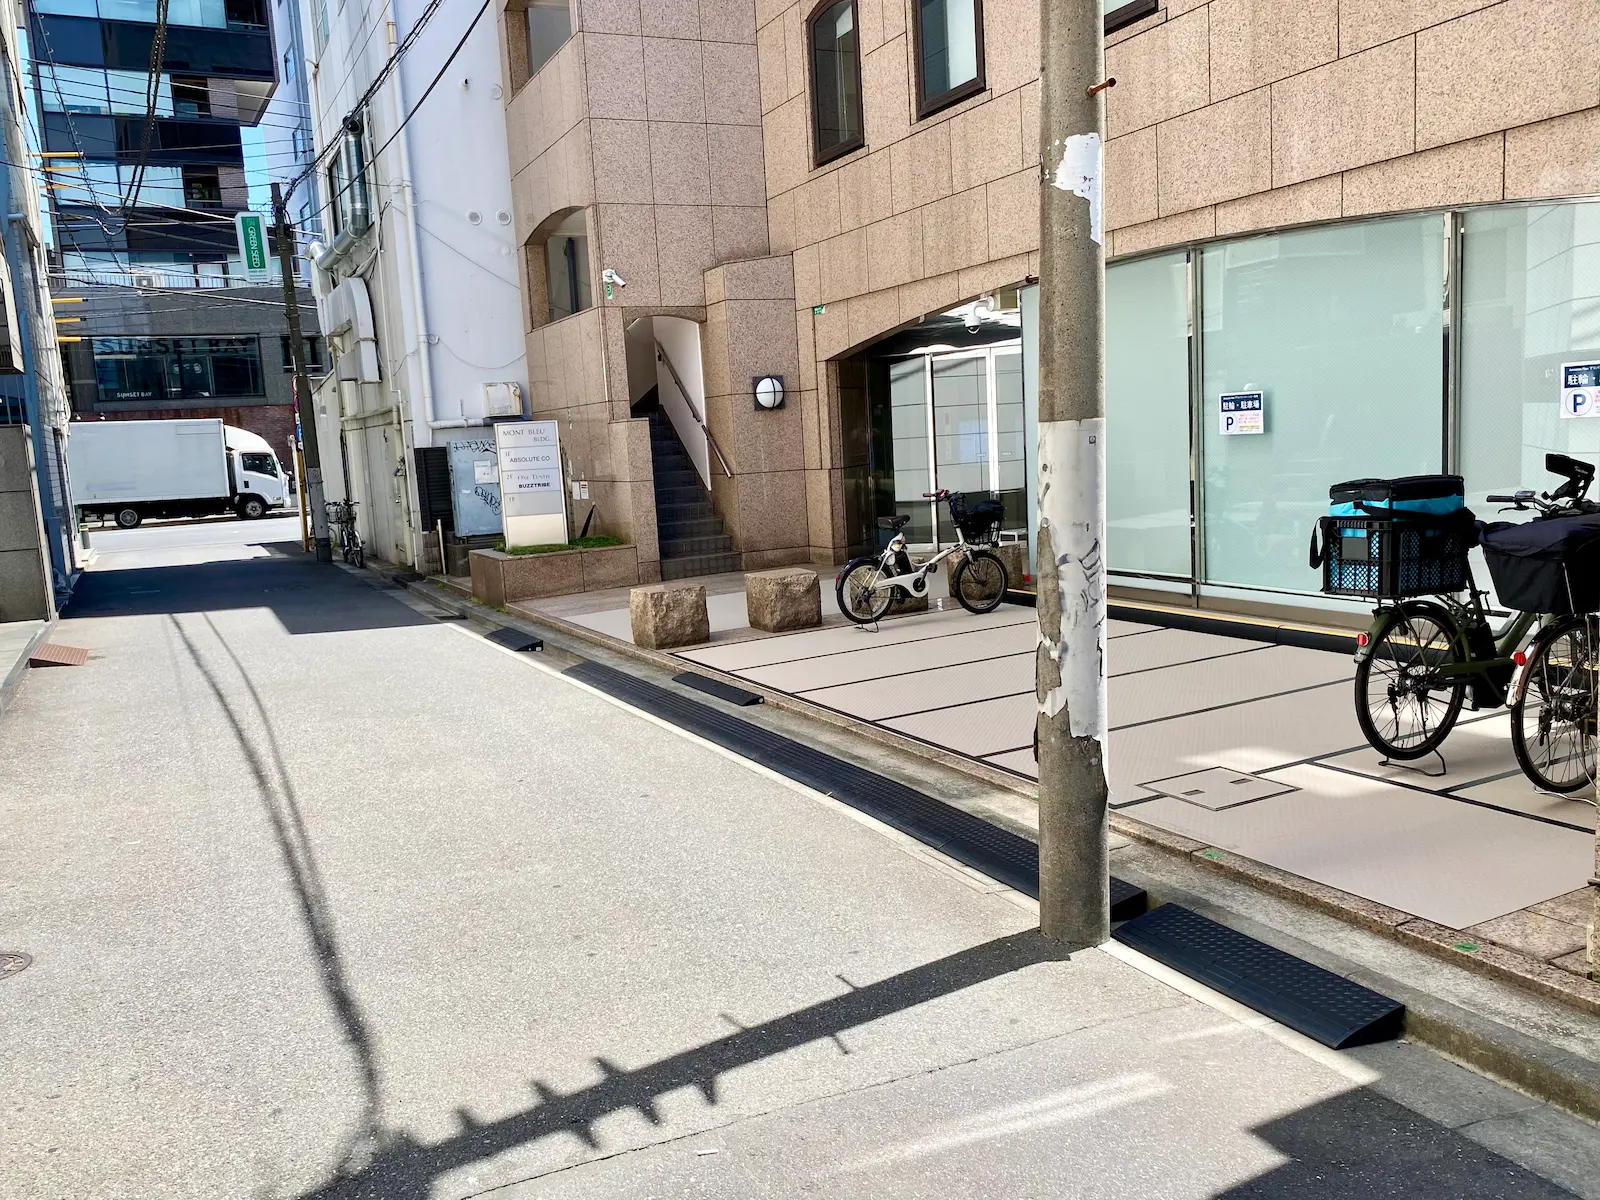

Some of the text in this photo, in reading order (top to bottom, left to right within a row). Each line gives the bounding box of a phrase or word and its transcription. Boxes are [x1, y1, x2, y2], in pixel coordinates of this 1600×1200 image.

[247, 226, 259, 250] GREEN
[251, 249, 261, 268] SEED
[100, 337, 256, 355] SUNSET BAY
[1567, 373, 1600, 386] 駐輪・
[1573, 393, 1587, 413] P
[1226, 416, 1234, 431] P
[503, 429, 525, 437] MONT
